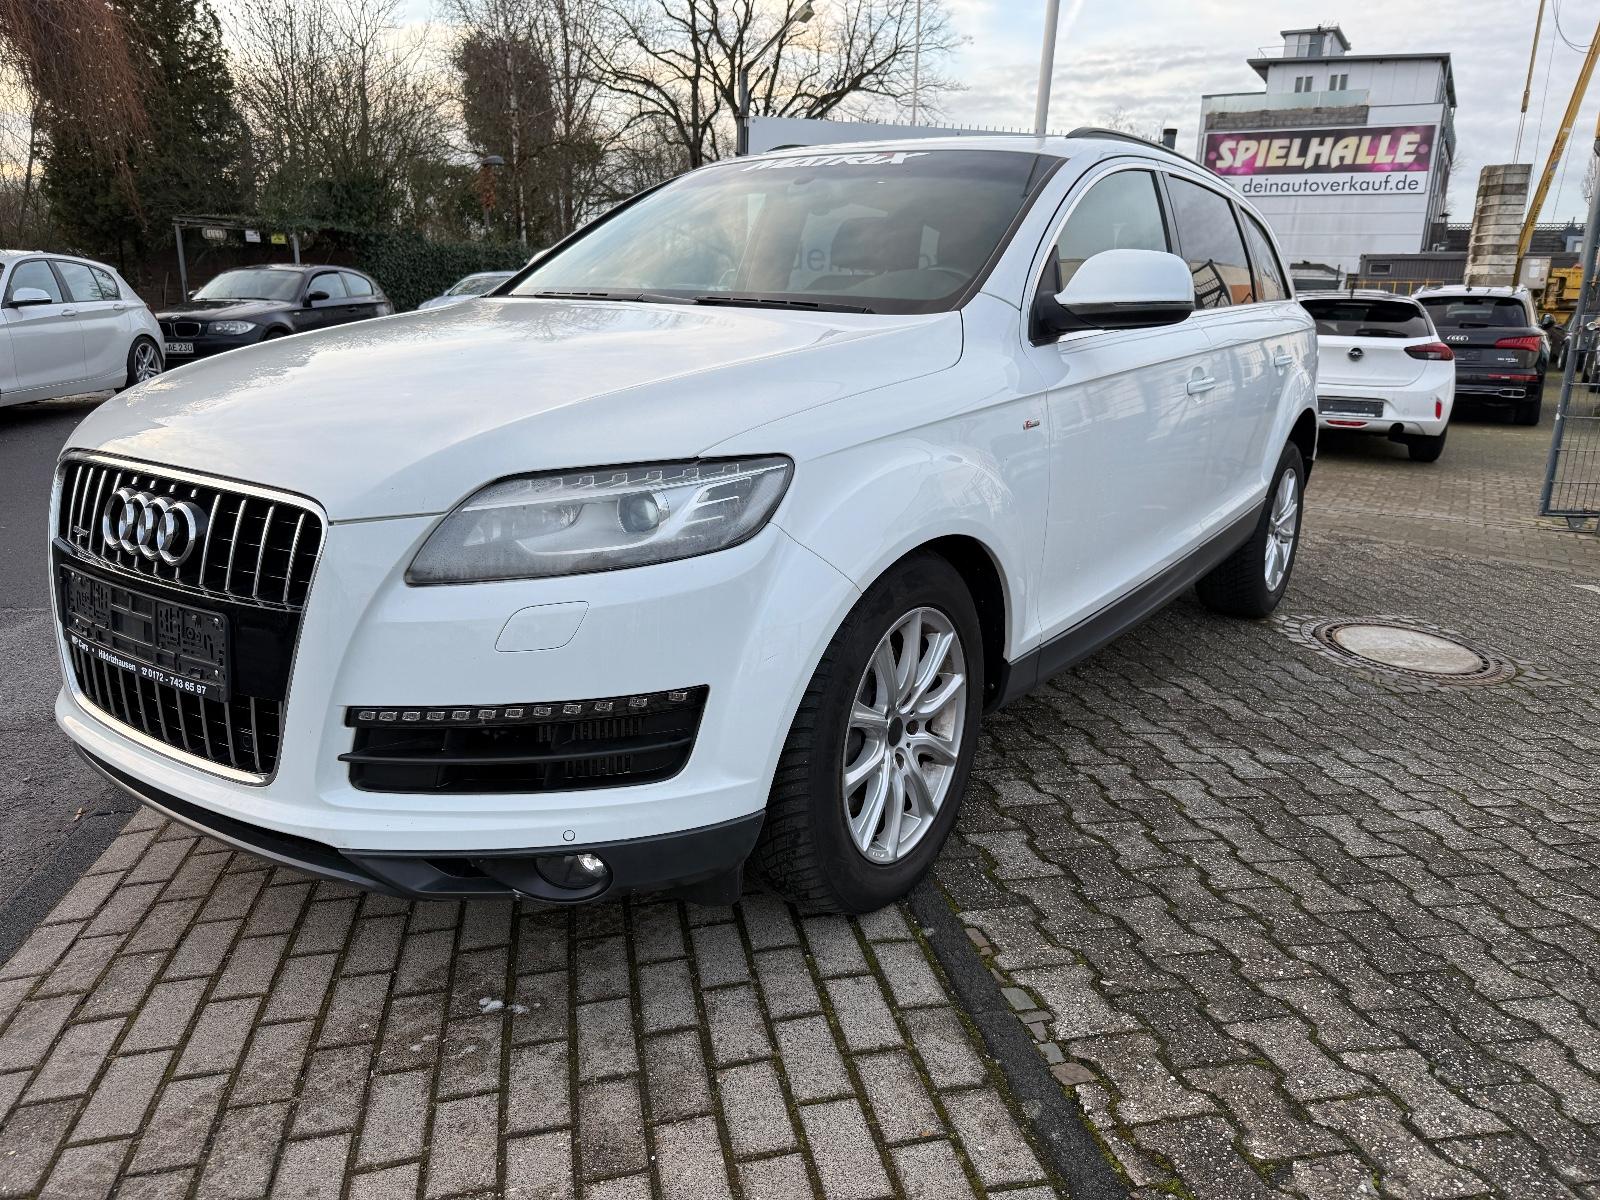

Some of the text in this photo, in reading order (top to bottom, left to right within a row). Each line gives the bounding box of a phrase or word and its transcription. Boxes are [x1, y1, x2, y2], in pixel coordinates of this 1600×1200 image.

[1215, 133, 1421, 170] SPIELHALLE
[1242, 174, 1419, 194] deinautoverkauf.de
[149, 668, 164, 682] 0172
[169, 676, 184, 689] 743
[184, 681, 195, 692] 65
[196, 684, 207, 695] 97
